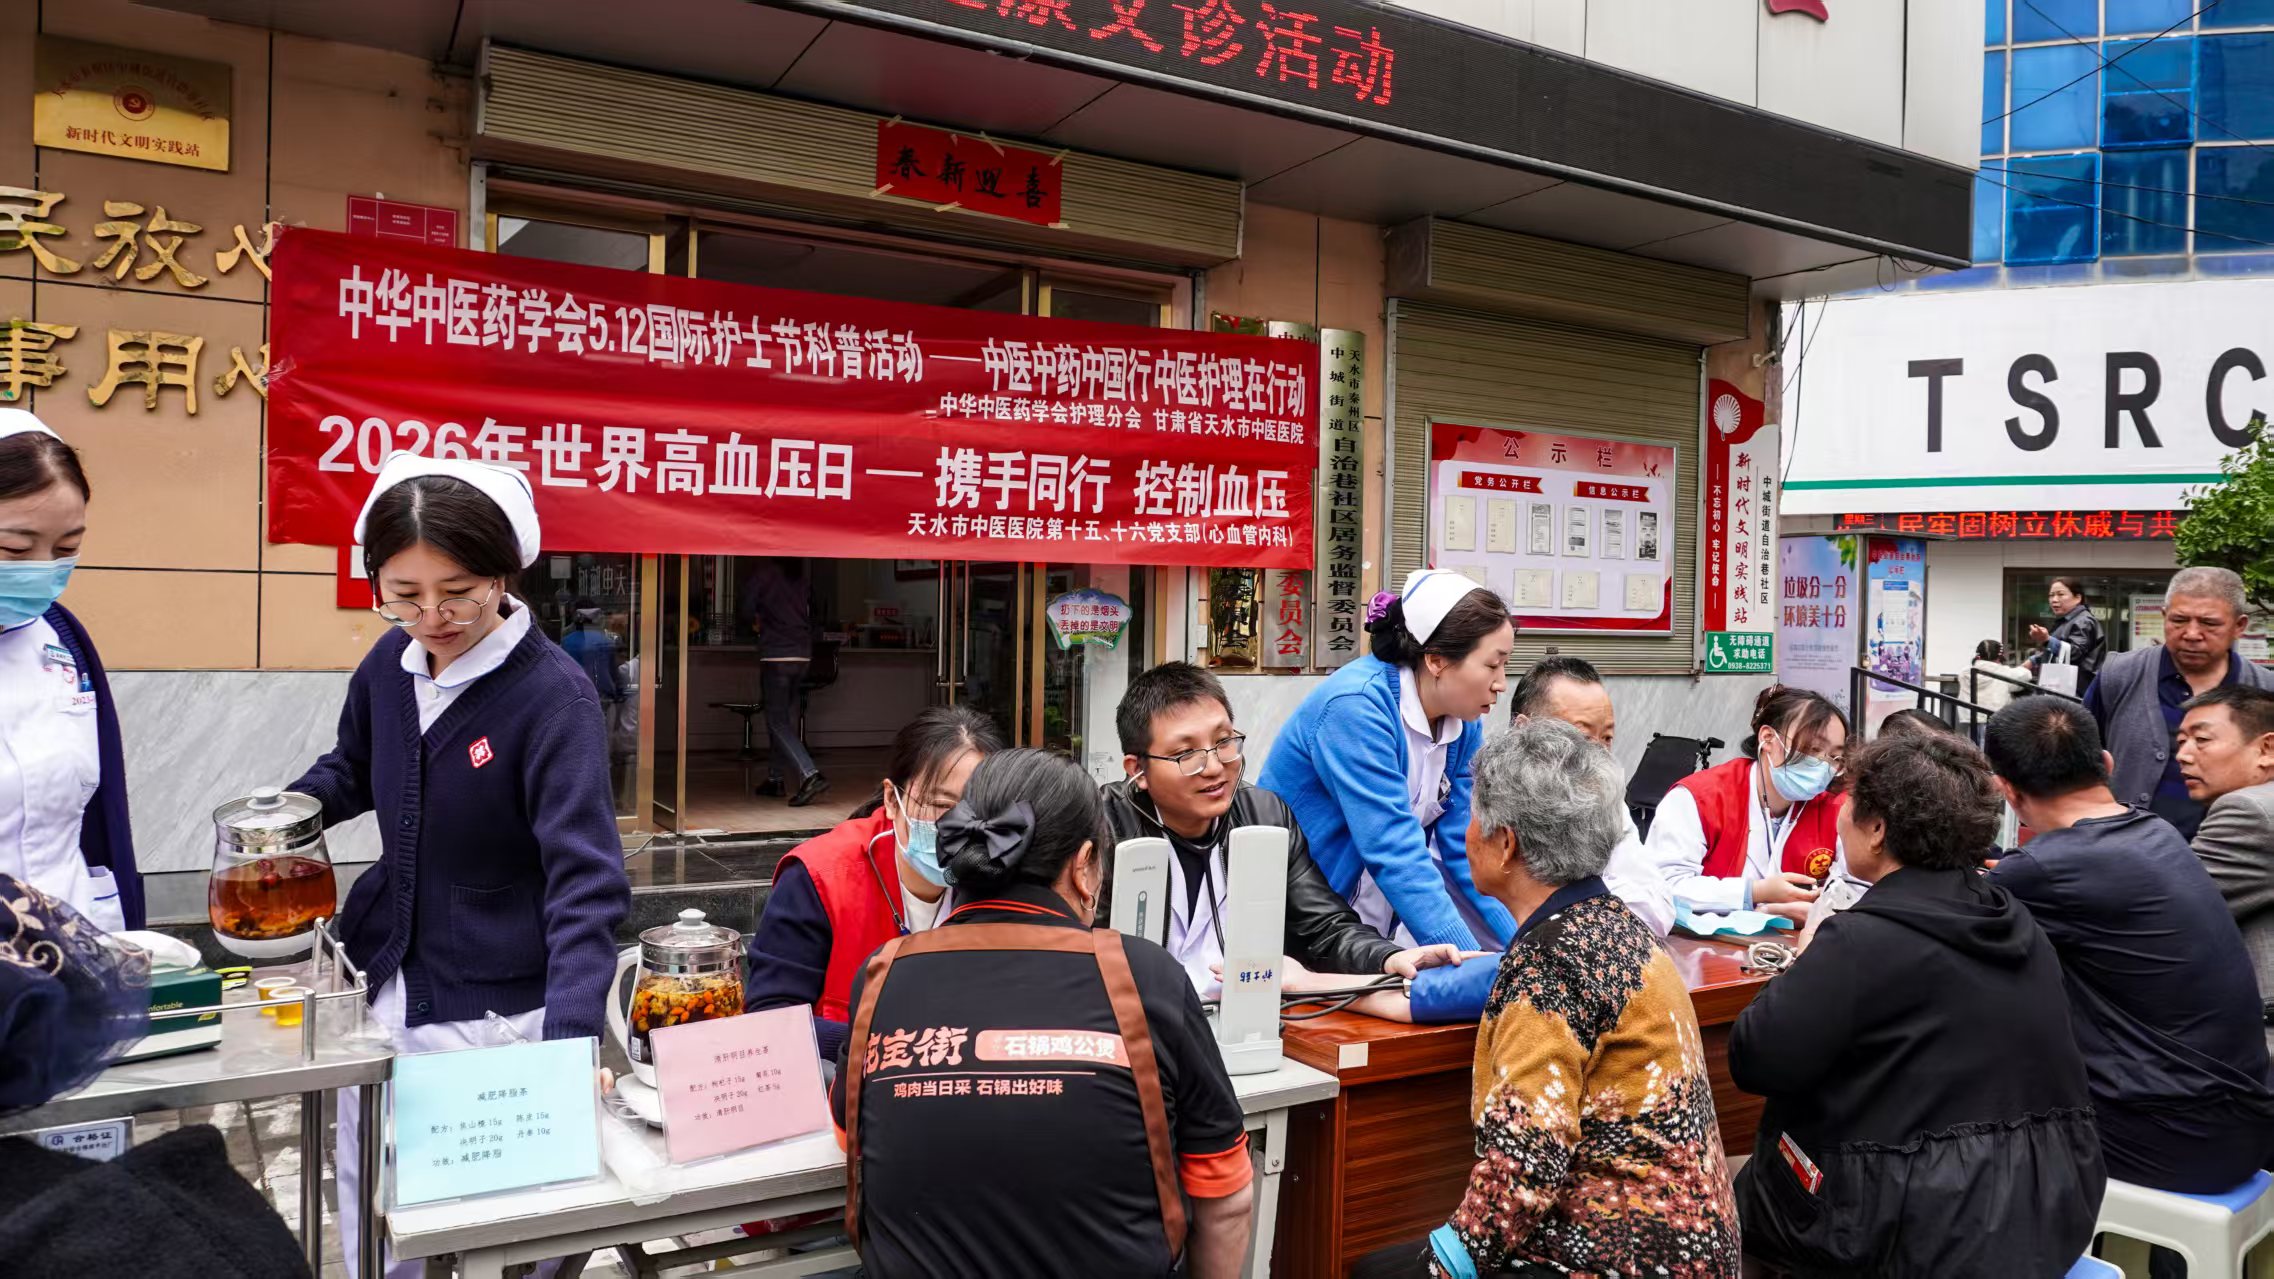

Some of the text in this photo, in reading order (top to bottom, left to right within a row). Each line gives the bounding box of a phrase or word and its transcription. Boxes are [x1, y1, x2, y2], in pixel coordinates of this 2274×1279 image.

[946, 0, 1394, 104] 义诊活动
[65, 125, 201, 157] 新时代文明实践站
[1328, 347, 1345, 431] 中城街道
[1348, 347, 1361, 433] 天水市秦州区
[1907, 347, 2267, 452] TSRC
[939, 391, 1305, 445] 中华中医药学会护理分会 甘肃省天水市中医医院
[1503, 436, 1614, 469] 公示栏
[1133, 458, 1290, 518] 控制血压
[1474, 475, 1641, 499] 党务公开栏 信息公示栏
[1327, 437, 1359, 653] 自治巷社区居务监督委员会
[1711, 485, 1722, 587] 不忘初心 牢记使命
[1733, 451, 1752, 625] 新时代文明实践站
[1760, 475, 1772, 605] 中城街道自治巷社区
[1784, 575, 1847, 599] 垃圾分一分
[1060, 604, 1119, 616] 扔下的是烟头
[1060, 620, 1119, 633] 丢掉的是文明
[1783, 605, 1847, 629] 环境美十分
[1729, 635, 1770, 647] 无障碍通道
[1733, 648, 1766, 660] 求助电话
[1727, 661, 1771, 670] 0938-8225371
[893, 1079, 1064, 1098] 鸡肉当日采 石锅出好味
